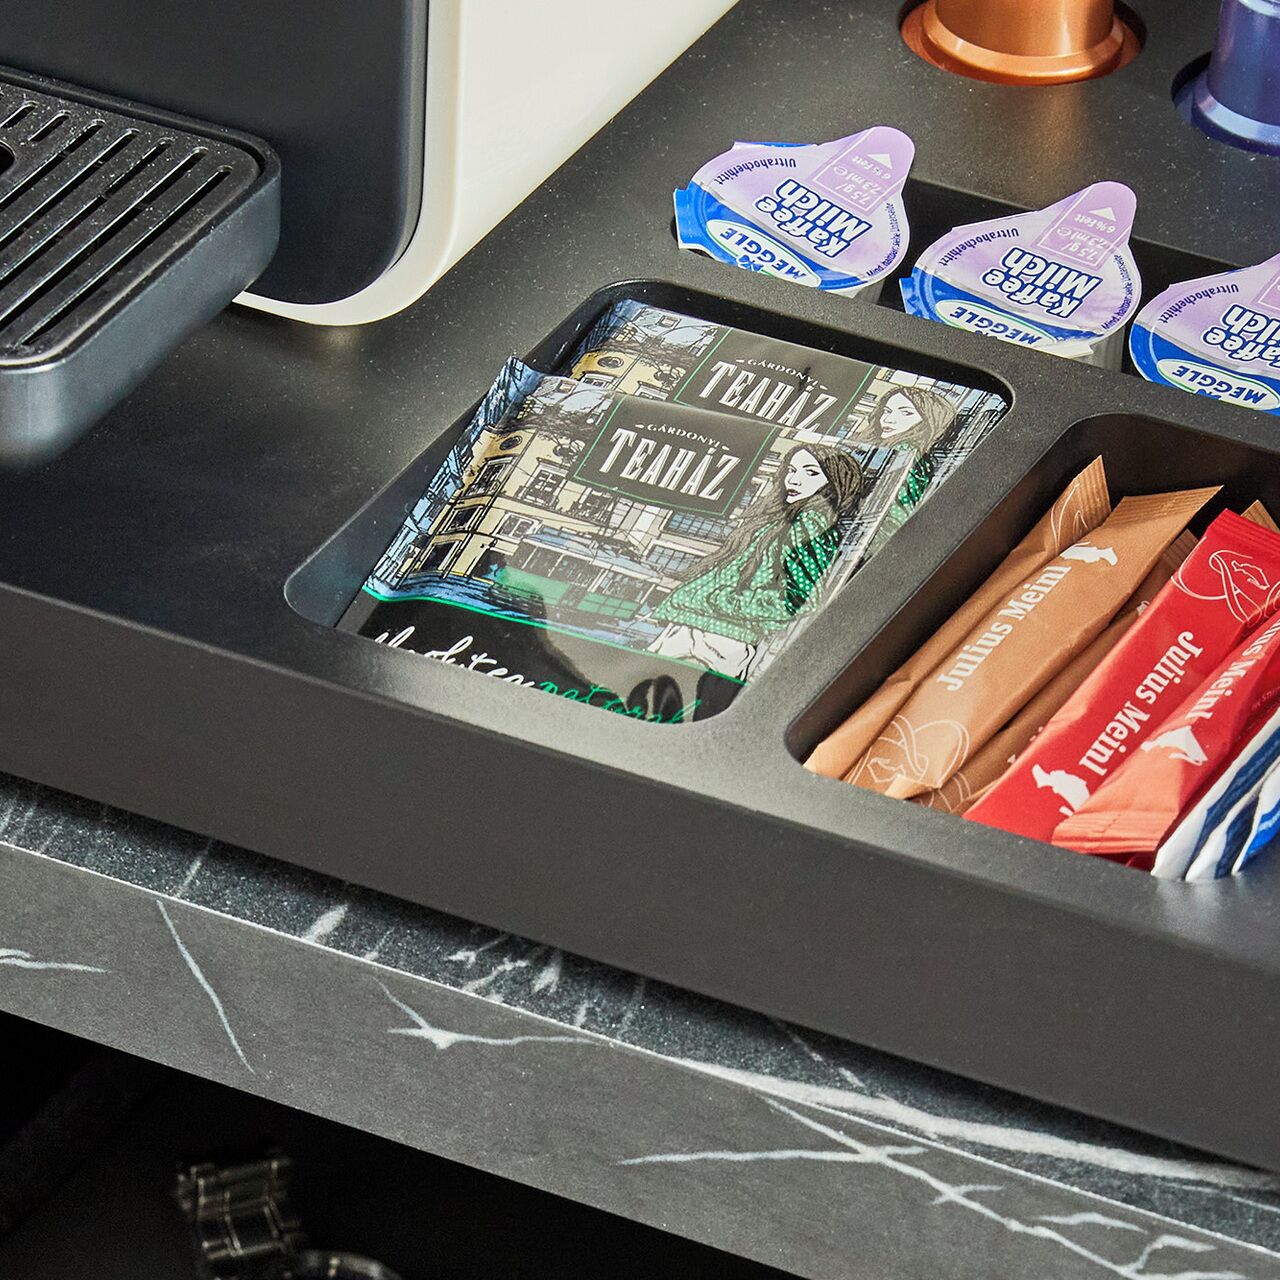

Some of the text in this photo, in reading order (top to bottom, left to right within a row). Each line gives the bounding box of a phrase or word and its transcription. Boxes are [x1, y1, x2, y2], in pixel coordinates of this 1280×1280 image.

[713, 157, 797, 185] Ultrahocherhitzt
[754, 196, 850, 258] Kaffee
[775, 178, 872, 246] Milch
[719, 227, 807, 280] MEGGLE
[938, 227, 1019, 266] Ultrahocherhitzt
[1000, 246, 1103, 301] Milch
[981, 268, 1084, 319] Kaffee
[1160, 283, 1240, 324] Ultrahocherhitzt
[950, 306, 1042, 345] MEGGLE
[699, 359, 839, 433] TEAHÁZ
[1172, 365, 1267, 405] MEGGLE
[599, 427, 742, 501] TEAHÁZ
[936, 564, 1073, 692] Julius Meinl
[1078, 630, 1205, 776] Julius Meinl
[1185, 658, 1258, 720] Meinl
